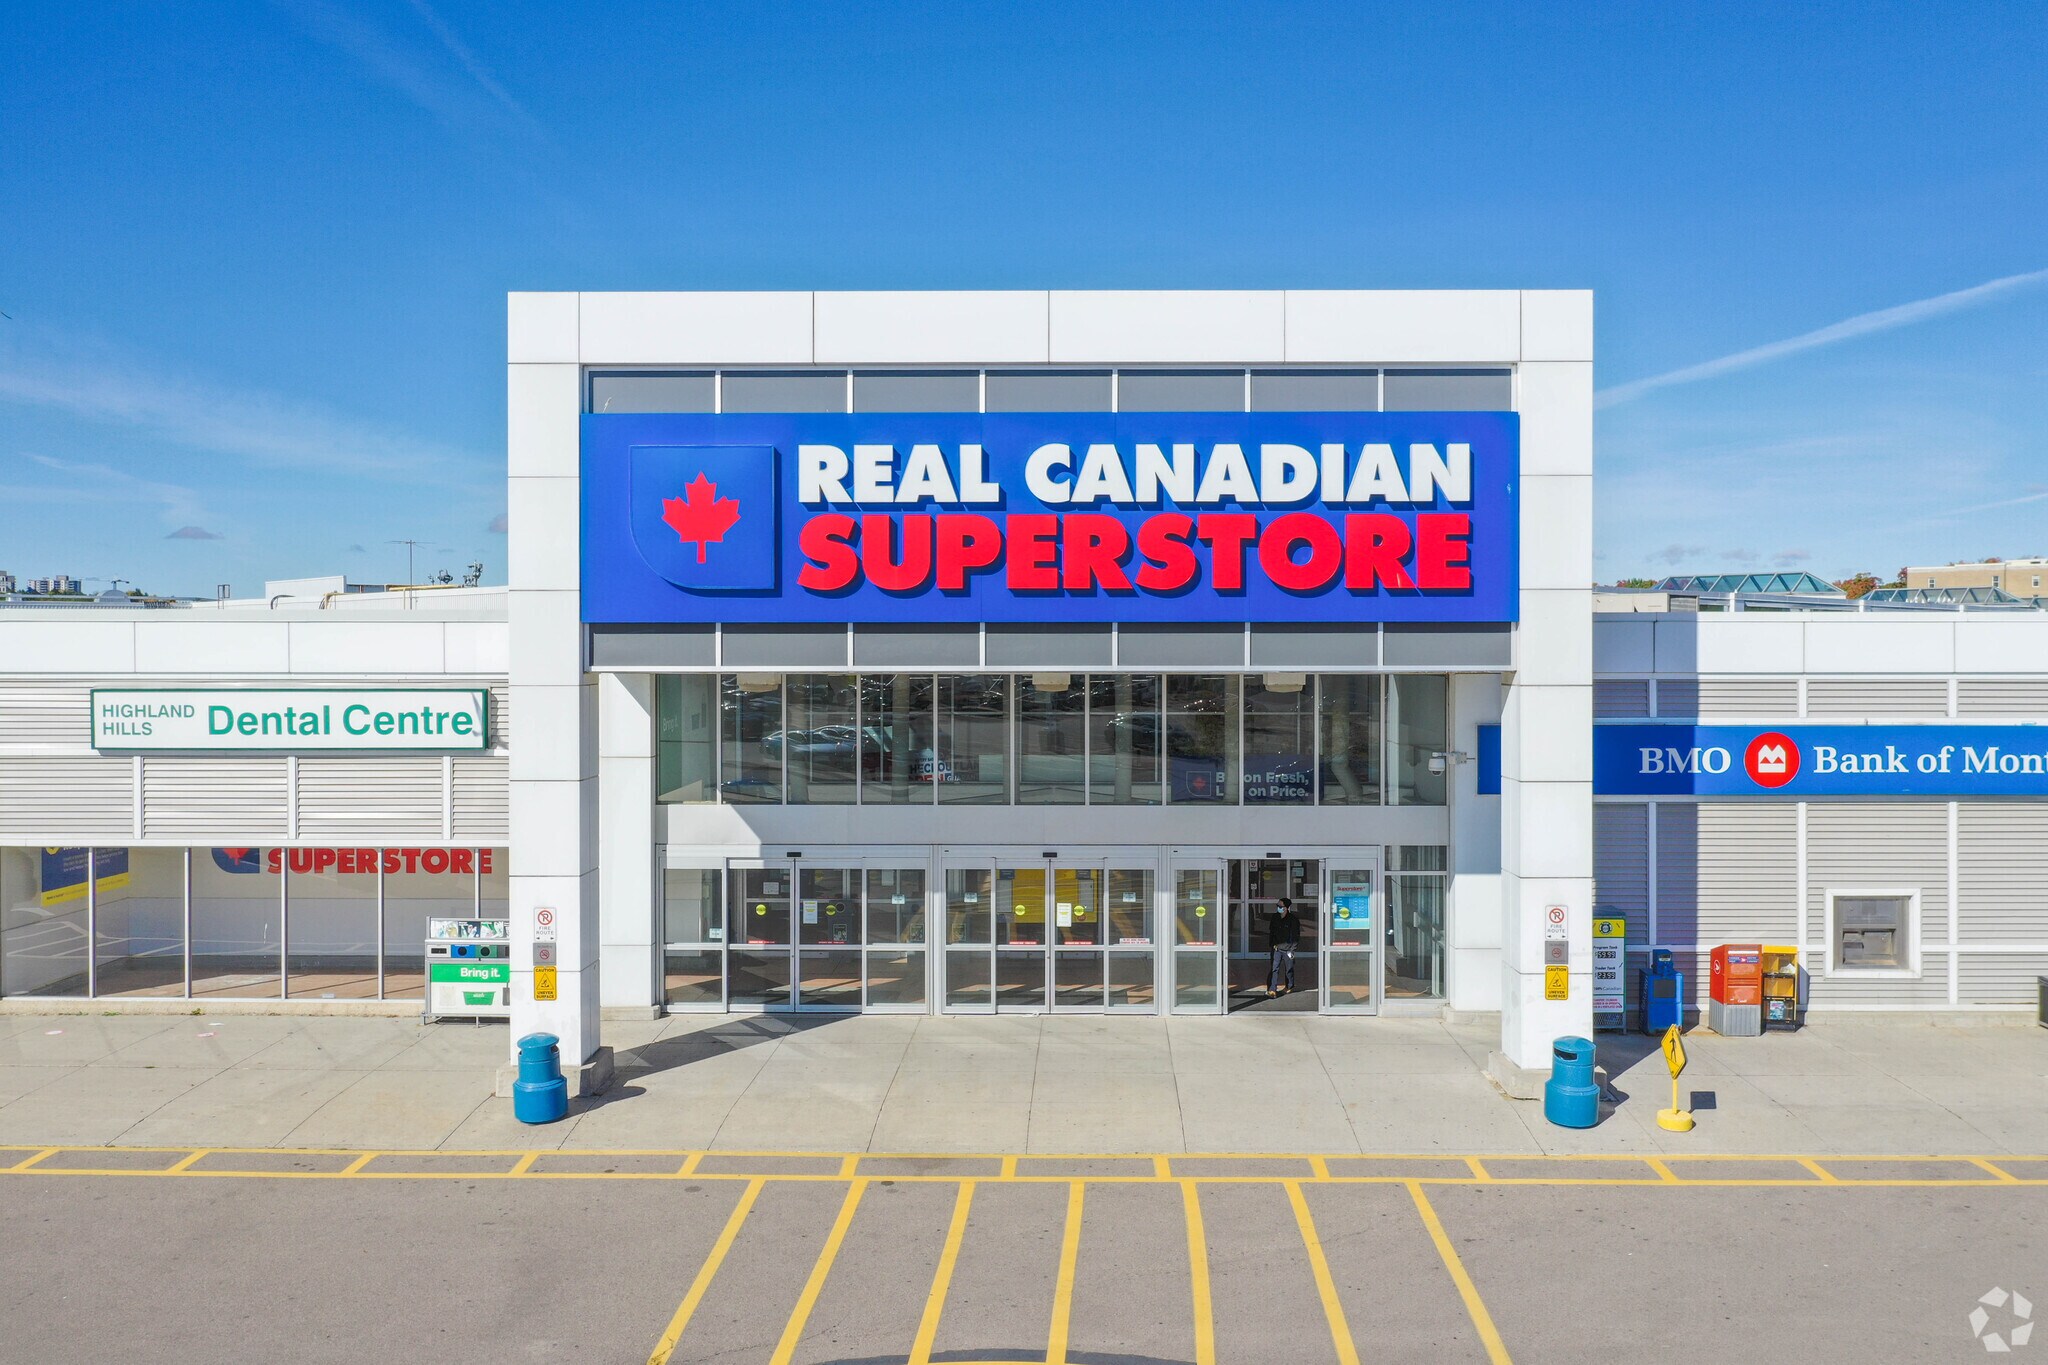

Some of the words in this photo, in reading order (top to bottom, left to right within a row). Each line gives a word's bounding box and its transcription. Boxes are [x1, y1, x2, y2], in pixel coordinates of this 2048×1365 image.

[798, 444, 1000, 503] REAL
[1024, 443, 1470, 503] CANADIAN
[797, 512, 1470, 590] SUPERSTORE
[102, 704, 195, 718] HIGHLAND
[208, 705, 330, 736] Dental
[343, 704, 473, 736] Centre
[103, 722, 153, 736] HILLS
[1638, 747, 1732, 774] BMO
[1813, 745, 1909, 774] Bank
[1916, 745, 1955, 774] of
[1244, 774, 1261, 783] on
[1266, 772, 1309, 785] Fresh,
[1248, 787, 1266, 797] on
[1270, 785, 1309, 797] Price.
[267, 847, 492, 874] SUPERSTORE
[461, 967, 488, 979] Bring
[491, 967, 500, 977] it.
